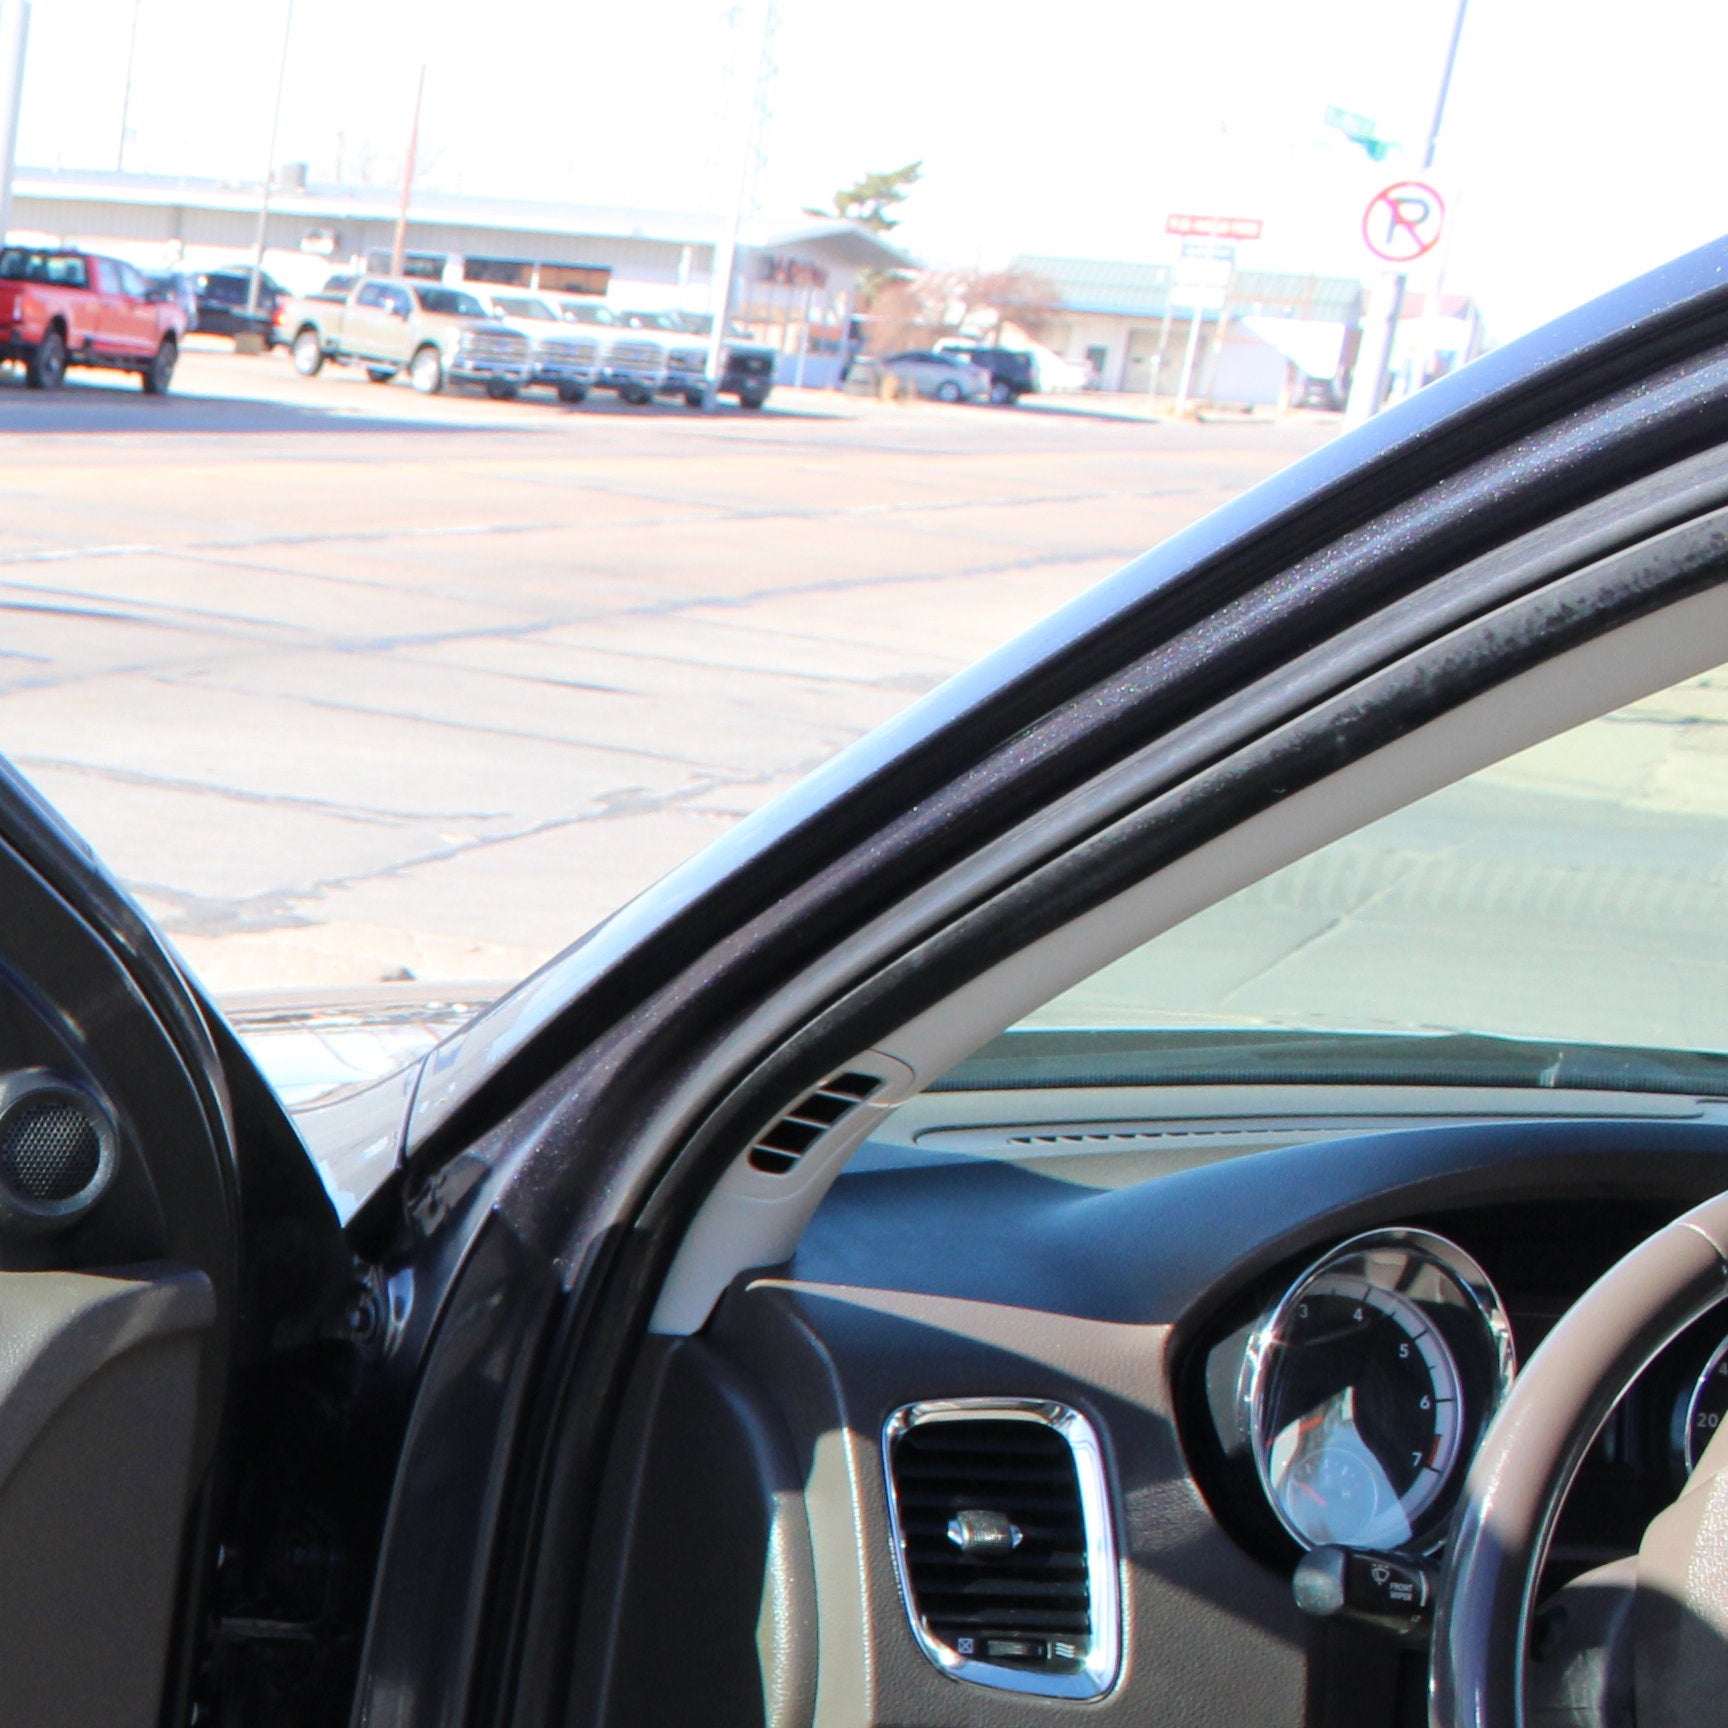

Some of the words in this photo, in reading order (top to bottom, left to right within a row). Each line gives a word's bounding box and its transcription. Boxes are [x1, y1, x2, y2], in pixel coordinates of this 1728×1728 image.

[1298, 1304, 1309, 1319] 3
[1352, 1308, 1364, 1322] 4
[1398, 1343, 1410, 1358] 5
[1420, 1394, 1431, 1410] 6
[1696, 1412, 1719, 1428] 20
[1411, 1452, 1423, 1467] 7
